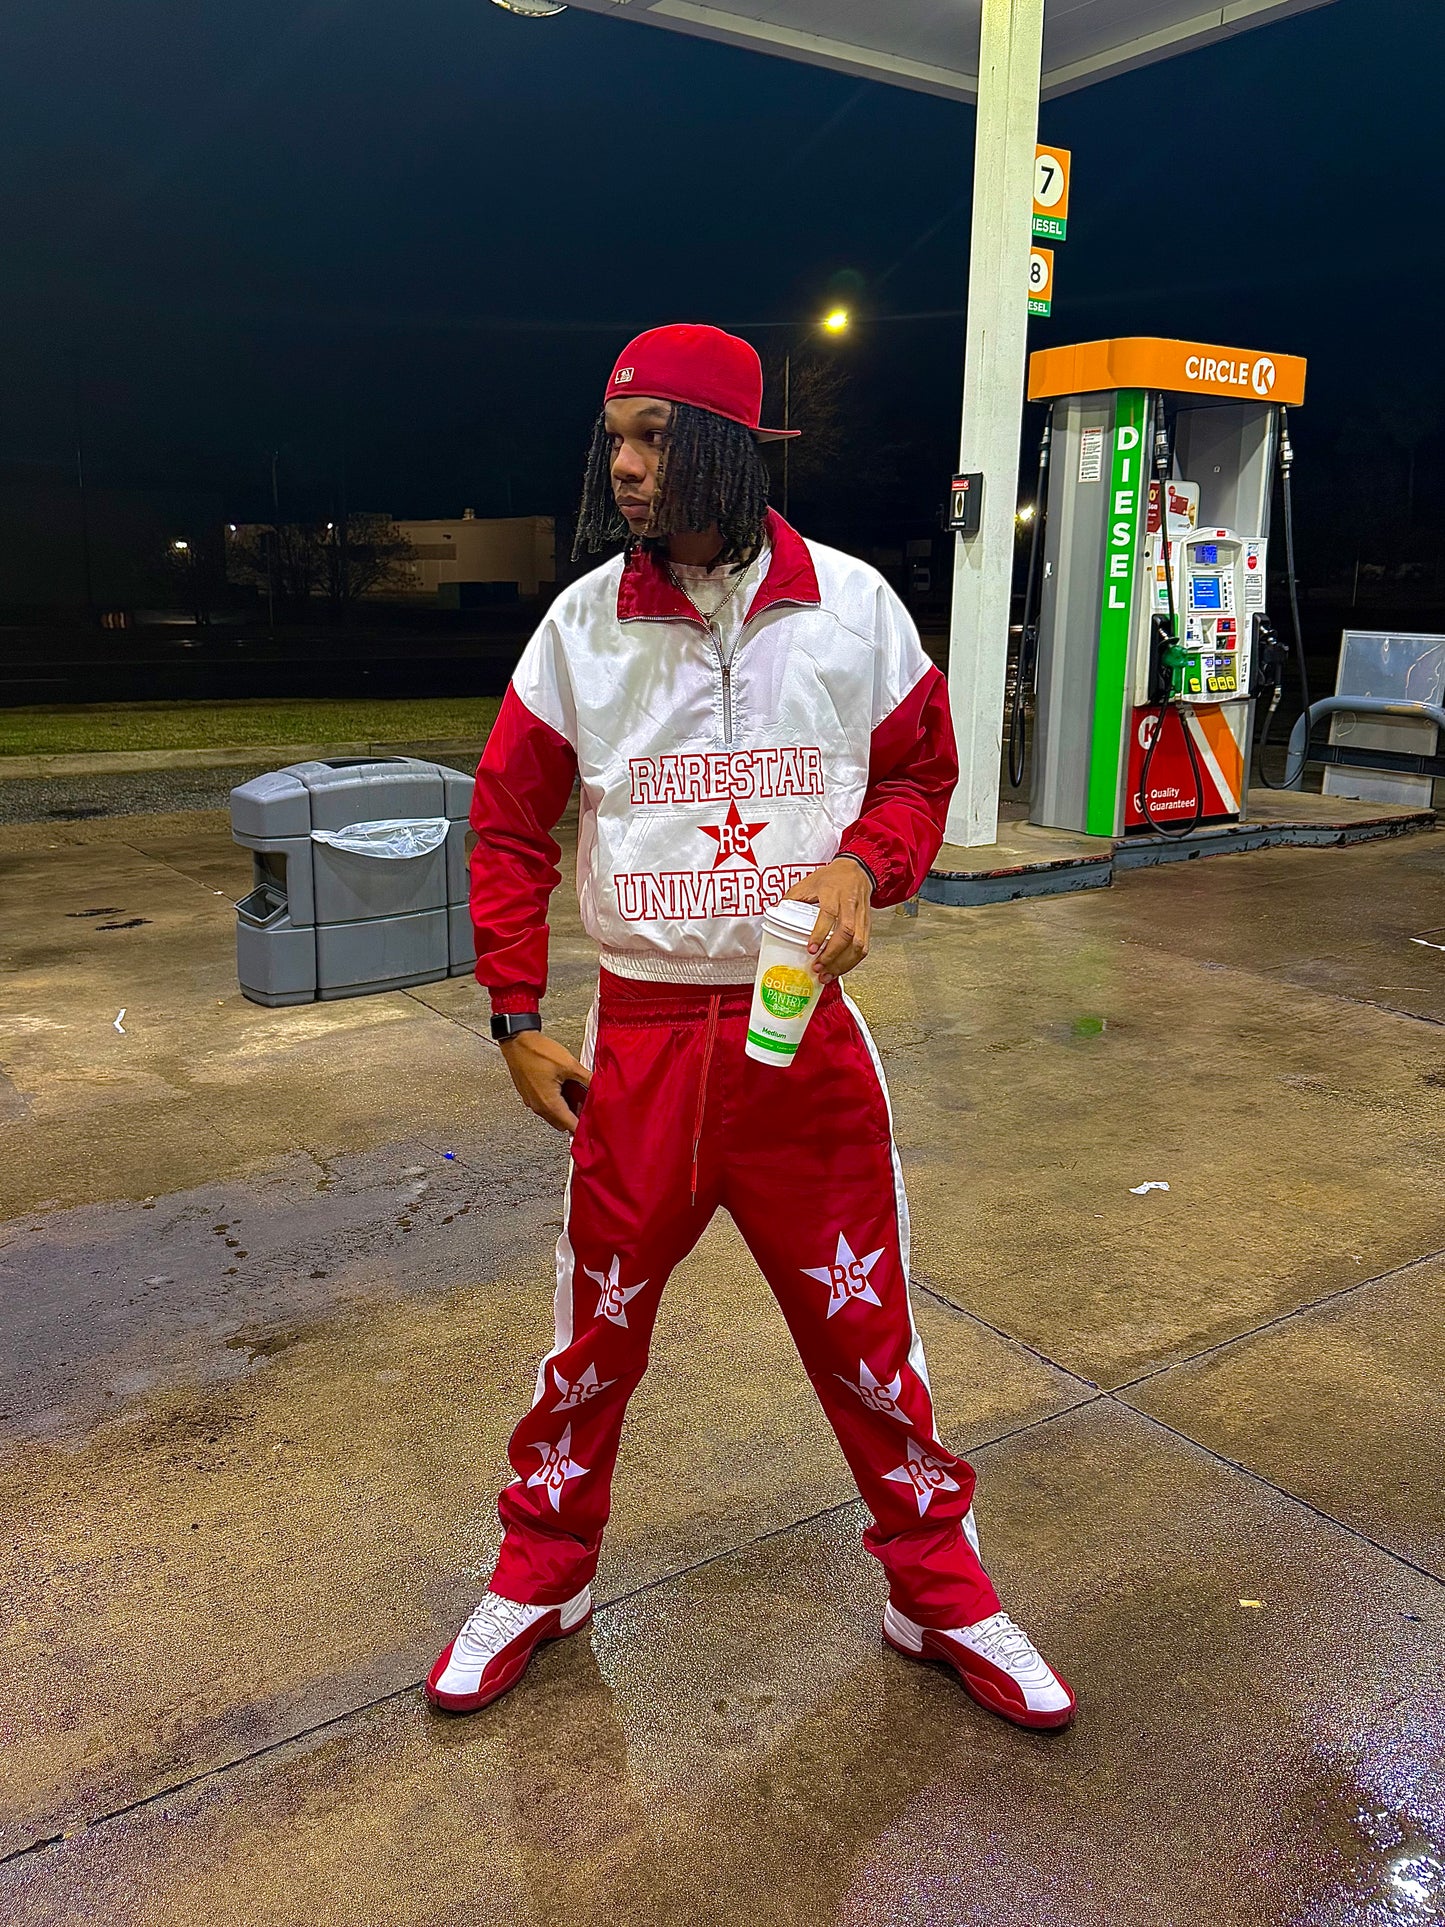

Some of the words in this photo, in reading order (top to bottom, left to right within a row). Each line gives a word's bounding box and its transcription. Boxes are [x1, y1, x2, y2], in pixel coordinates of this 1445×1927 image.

[1040, 166, 1055, 194] 7
[1032, 217, 1063, 235] IESEL
[1030, 262, 1041, 283] 8
[1028, 300, 1048, 313] ESEL
[1185, 356, 1250, 385] CIRCLE
[1254, 360, 1275, 395] K
[1108, 426, 1139, 609] DIESEL
[629, 747, 824, 804] RARESTAR
[1150, 787, 1180, 799] Quality
[1150, 797, 1196, 812] Guaranteed
[719, 824, 749, 854] RS
[614, 863, 830, 921] UNIVERSI
[766, 989, 804, 1008] PANTRY
[761, 1027, 787, 1039] Medium
[600, 1270, 624, 1317] RS
[828, 1261, 867, 1300] RS
[859, 1385, 895, 1411] RS
[538, 1448, 570, 1490] RS
[904, 1454, 946, 1496] RS
